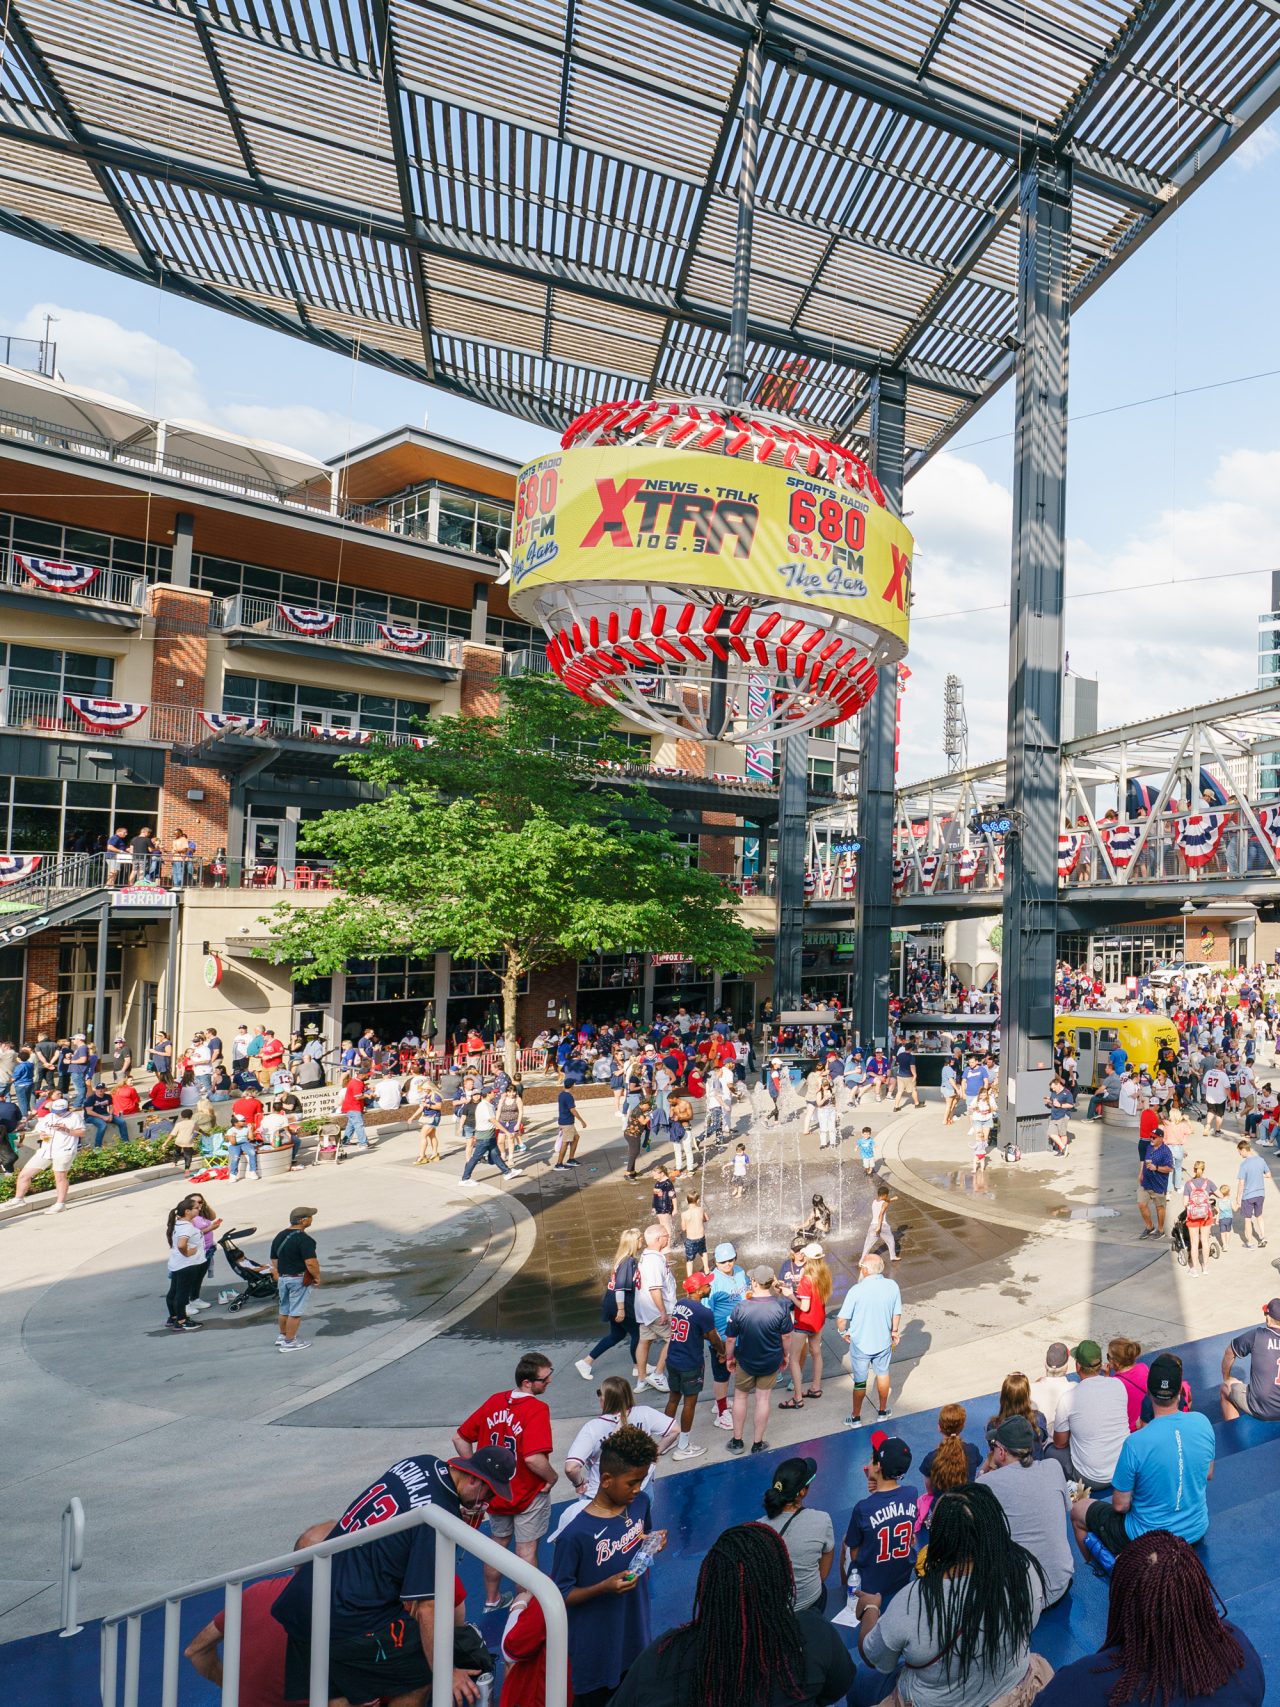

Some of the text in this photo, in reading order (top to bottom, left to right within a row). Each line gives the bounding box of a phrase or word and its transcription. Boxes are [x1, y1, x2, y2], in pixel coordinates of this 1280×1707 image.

[538, 458, 562, 471] RADIO
[517, 469, 558, 526] 680
[645, 480, 760, 504] NEWS TALK
[786, 476, 870, 513] SPORTS RADIO
[579, 478, 760, 560] XTRA
[789, 489, 866, 552] 680
[636, 534, 706, 553] 106.3
[778, 563, 866, 592] The Fan
[108, 890, 177, 907] TERRAPIN
[803, 932, 838, 944] ERRAPIN
[301, 1092, 331, 1100] NATIONAL
[1208, 1077, 1219, 1087] 27
[486, 1408, 513, 1429] ACUÑA
[388, 1459, 430, 1494] ACUÑA
[340, 1483, 399, 1533] 13
[869, 1501, 905, 1529] ACUÑA
[596, 1519, 645, 1566] Braves
[876, 1520, 913, 1563] 13
